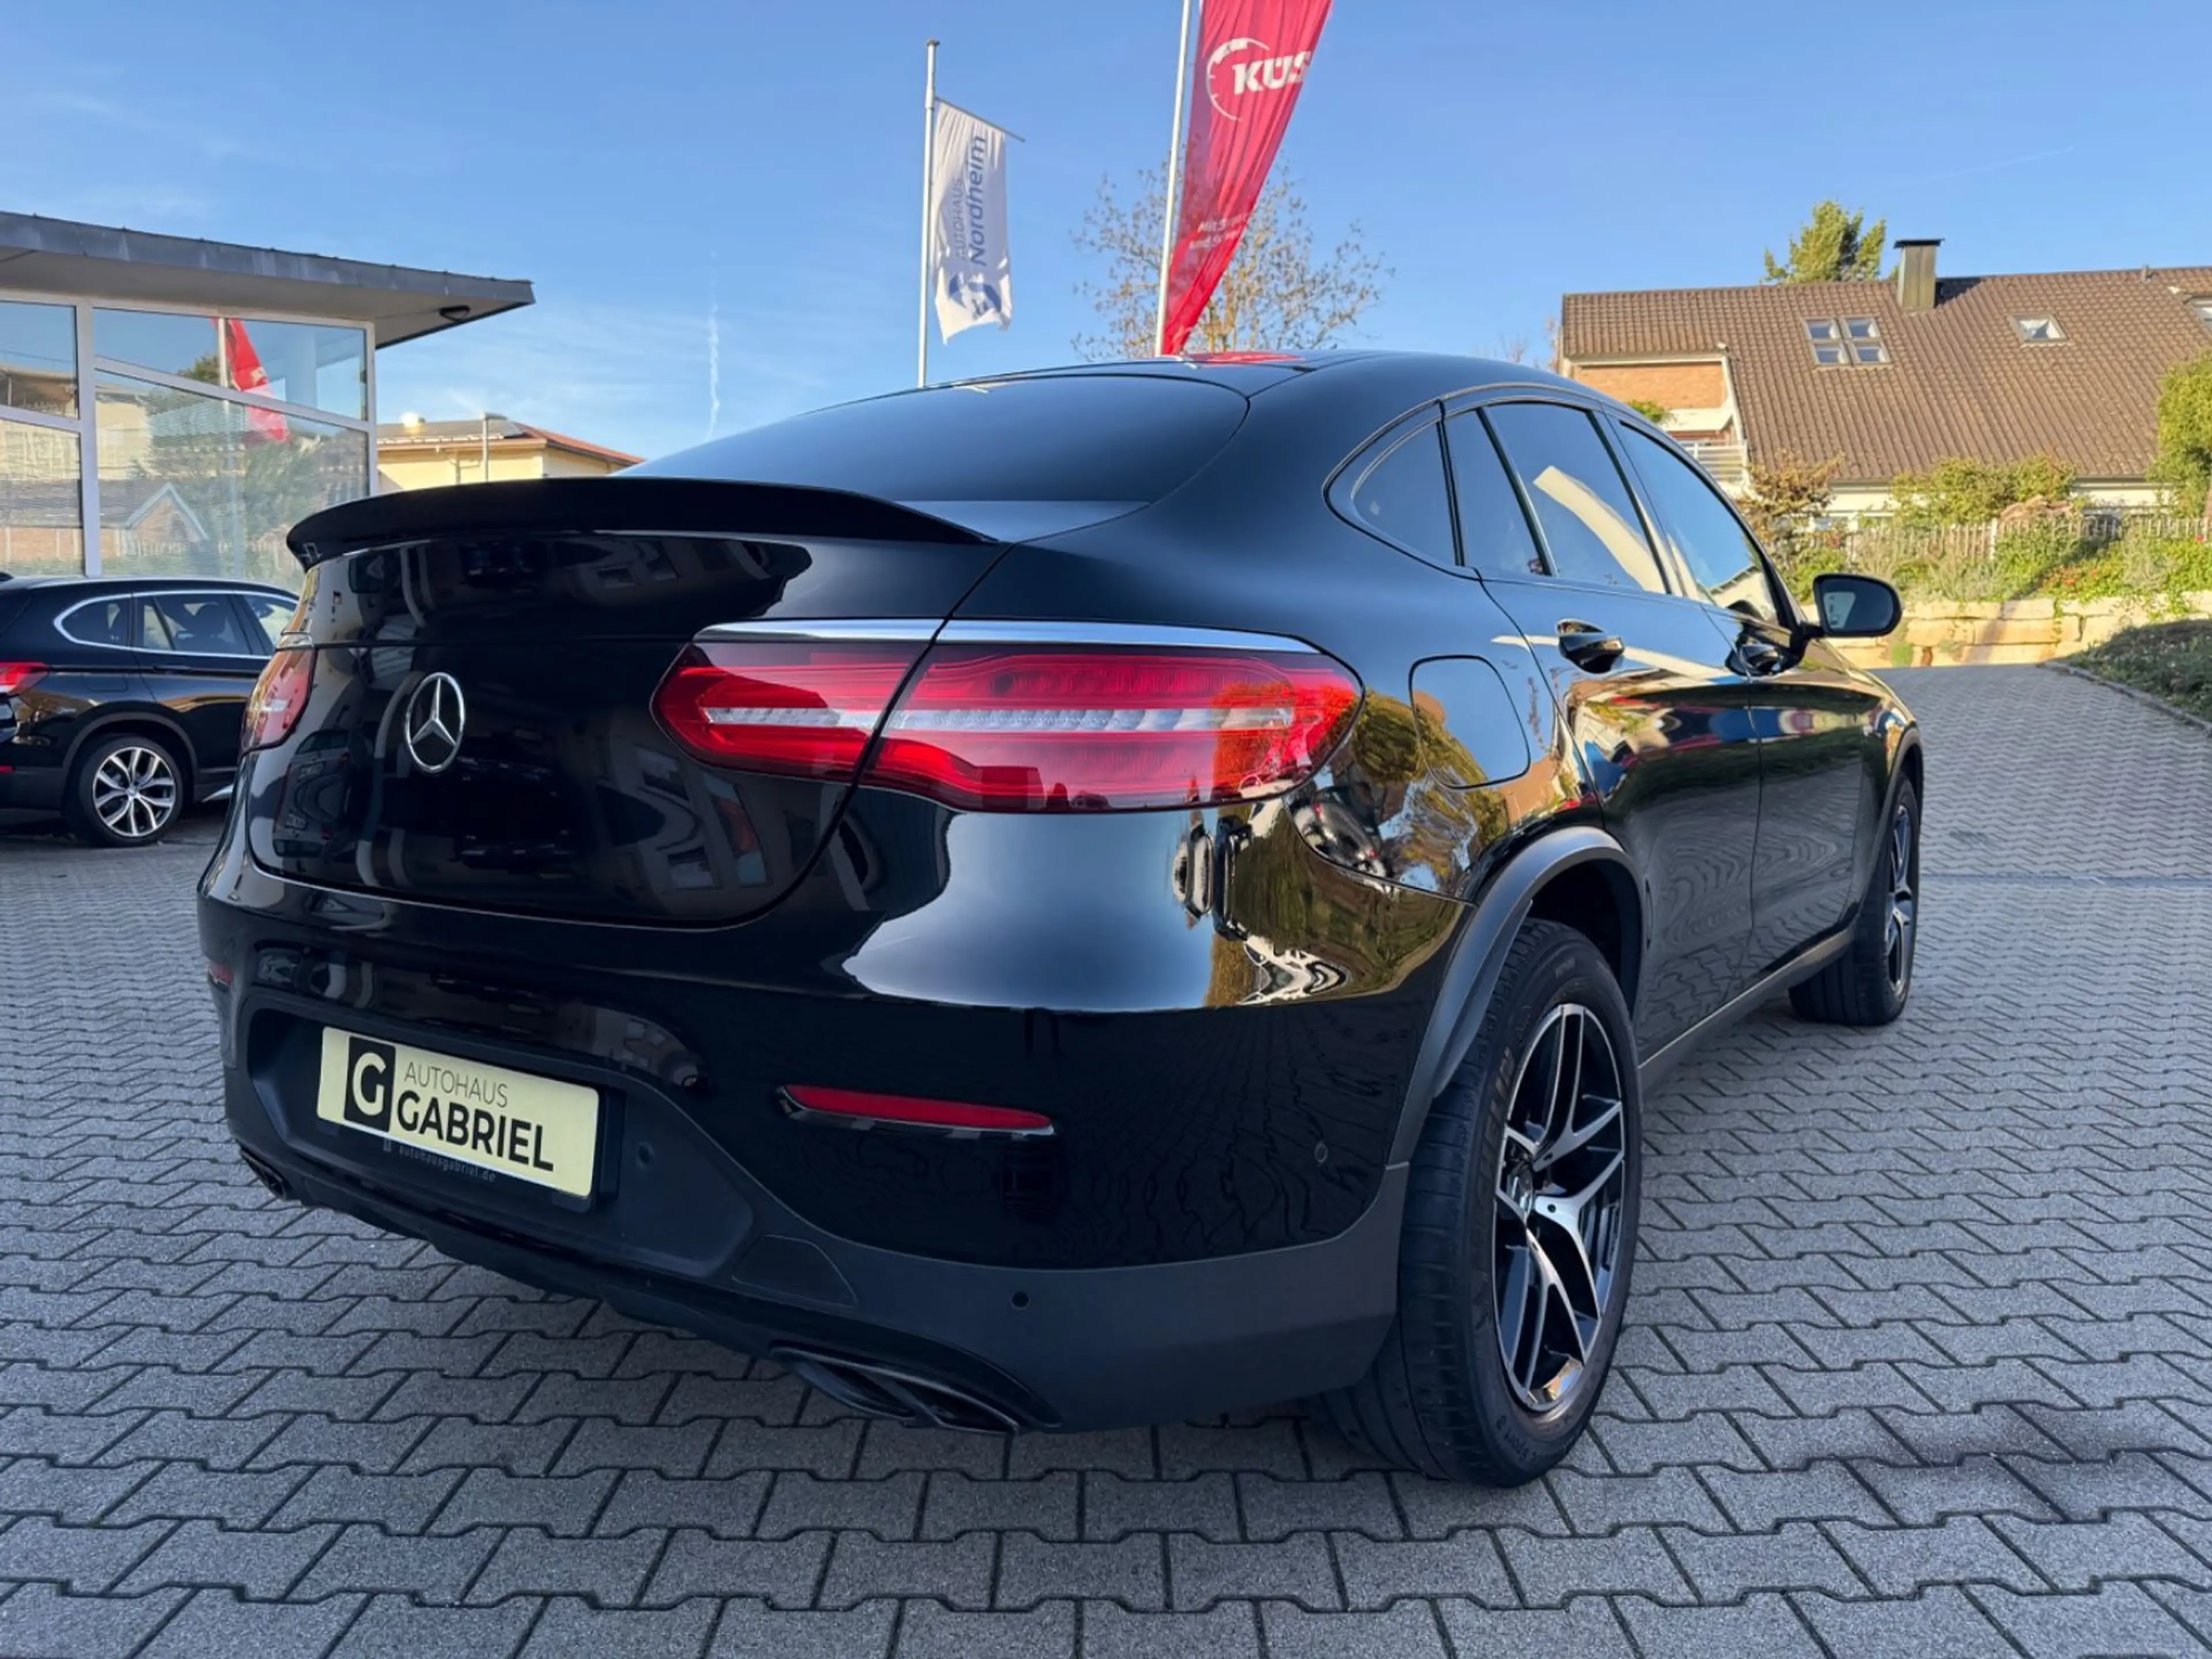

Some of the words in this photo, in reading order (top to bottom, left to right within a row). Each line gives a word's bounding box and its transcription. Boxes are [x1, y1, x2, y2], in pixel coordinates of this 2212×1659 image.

[952, 177, 966, 261] AUTOHAUS
[966, 135, 987, 267] Nordheim
[352, 1052, 387, 1116] G
[404, 1062, 508, 1108] AUTOHAUS
[397, 1090, 554, 1172] GABRIEL
